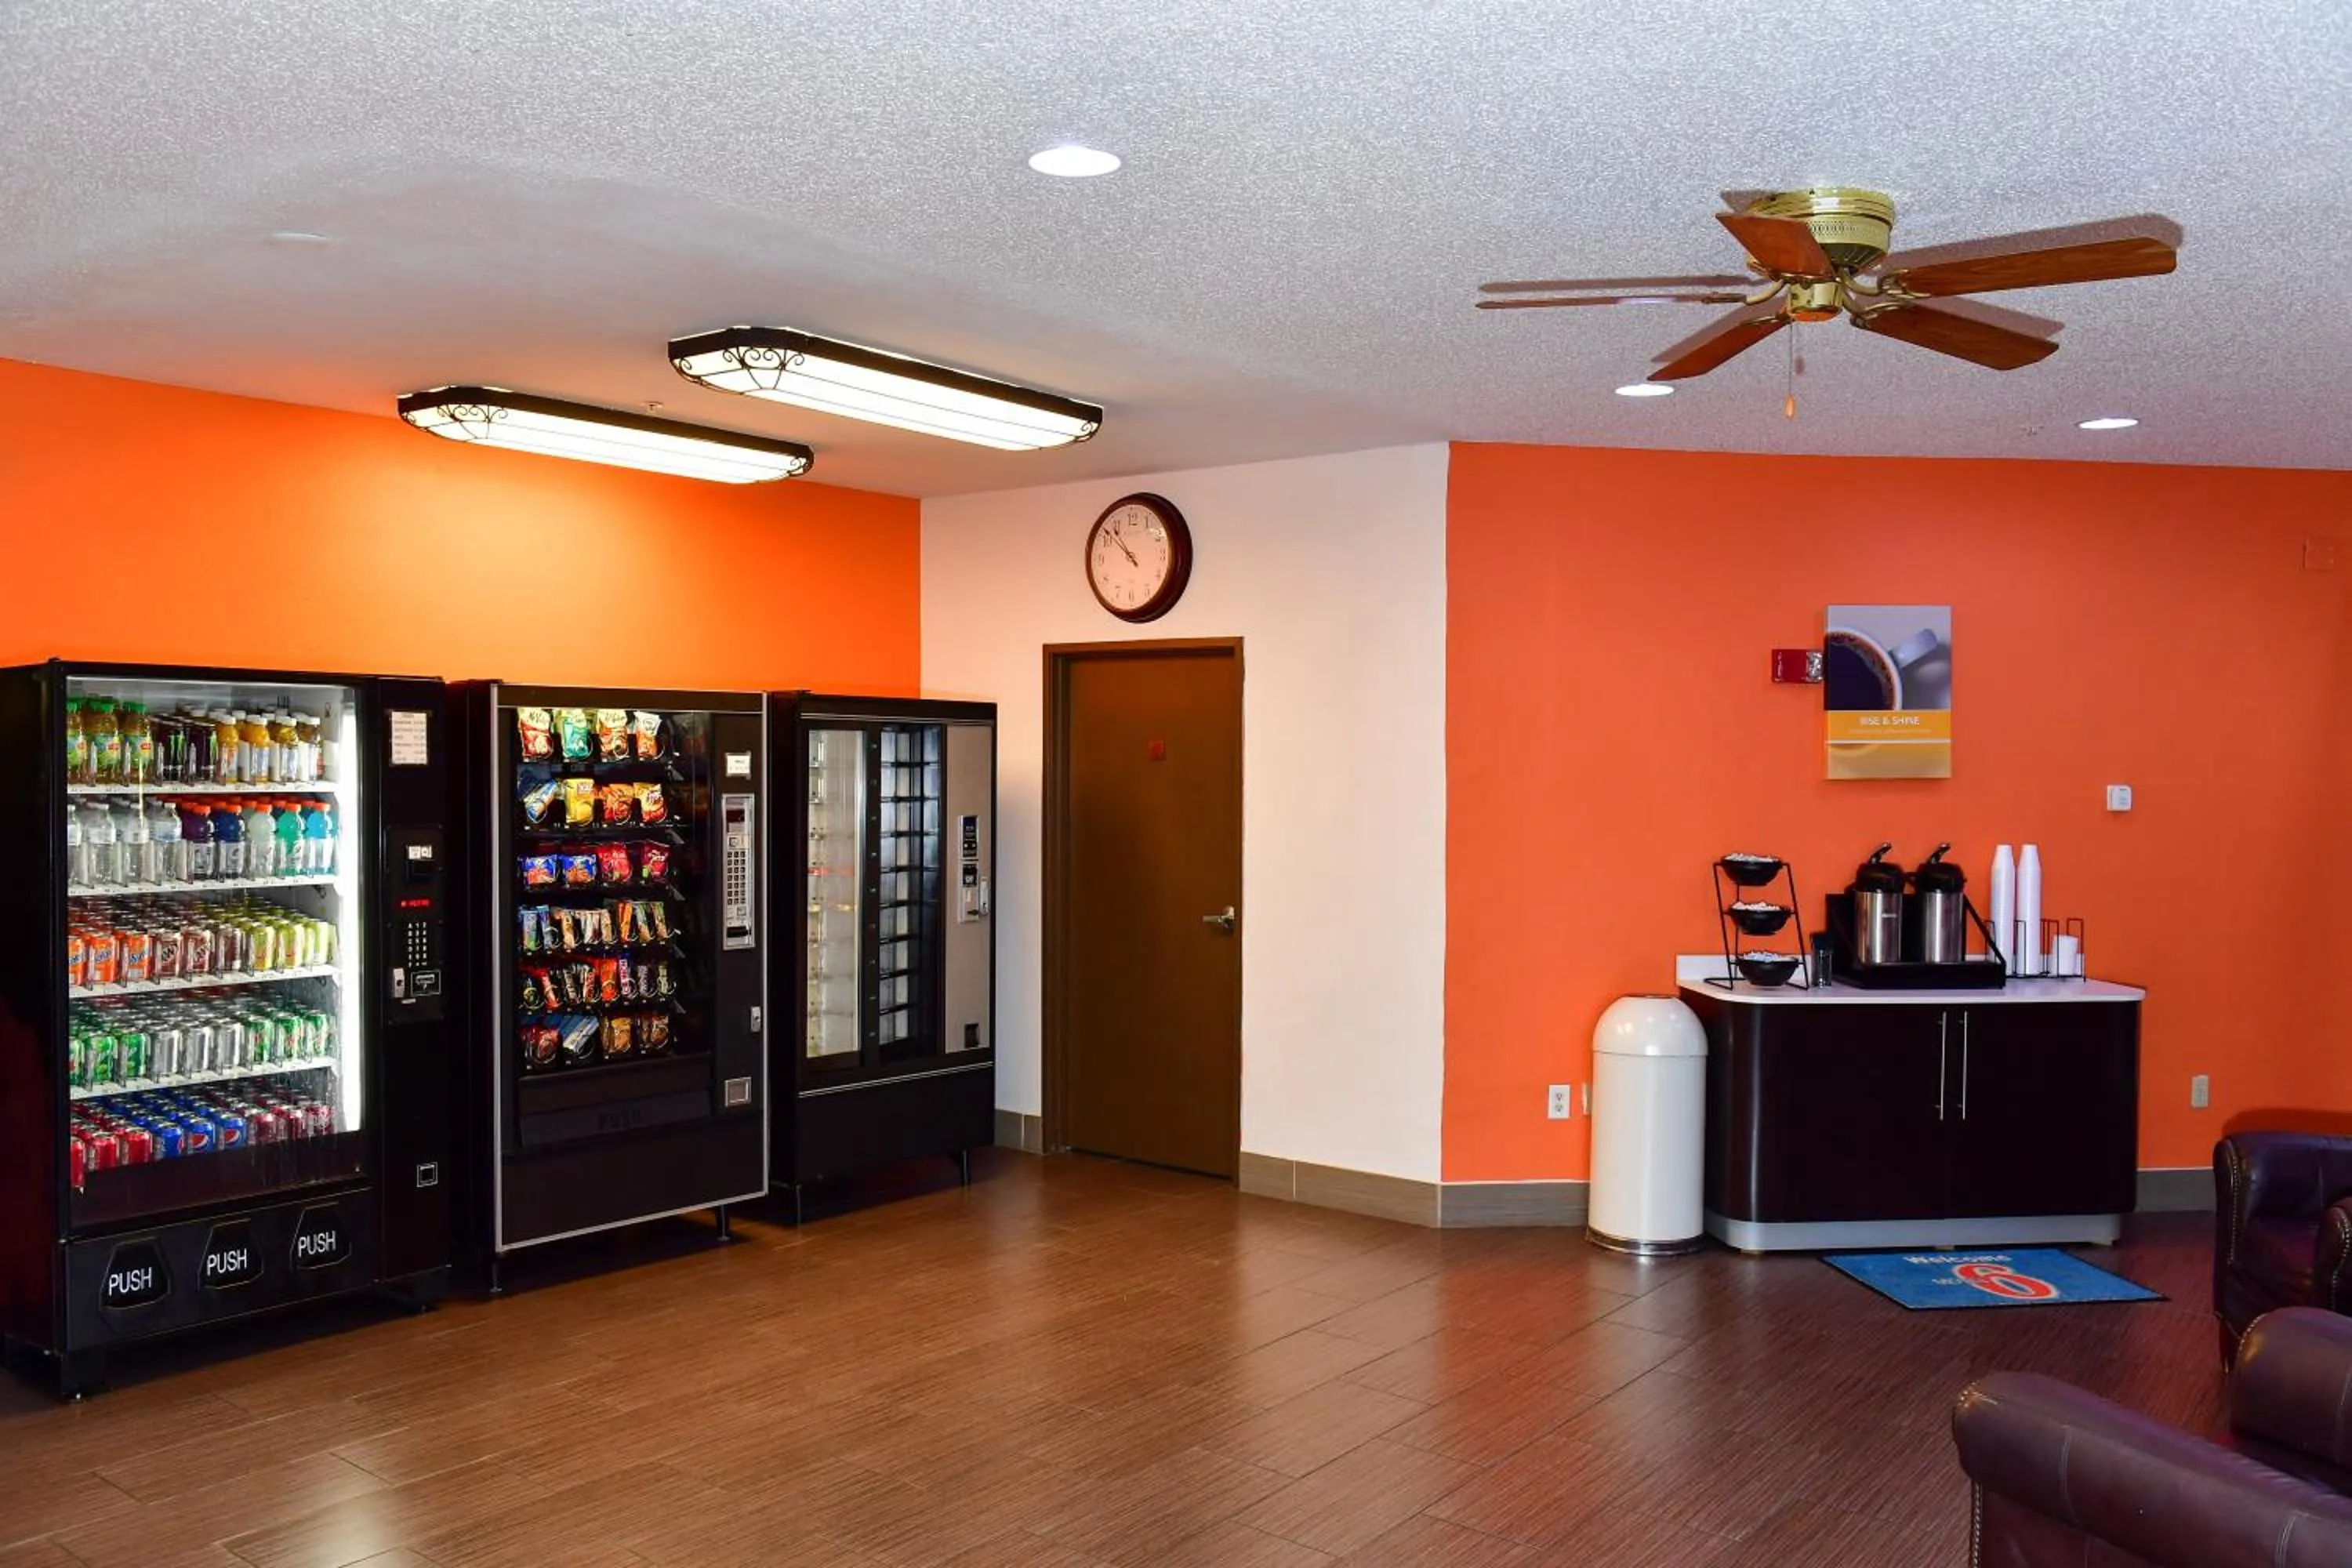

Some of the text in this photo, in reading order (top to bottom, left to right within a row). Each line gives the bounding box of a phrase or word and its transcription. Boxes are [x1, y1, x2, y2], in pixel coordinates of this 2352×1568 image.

[1892, 716, 1920, 725] SHINE
[297, 1230, 336, 1258] PUSH
[206, 1248, 248, 1276] PUSH
[108, 1266, 152, 1296] PUSH
